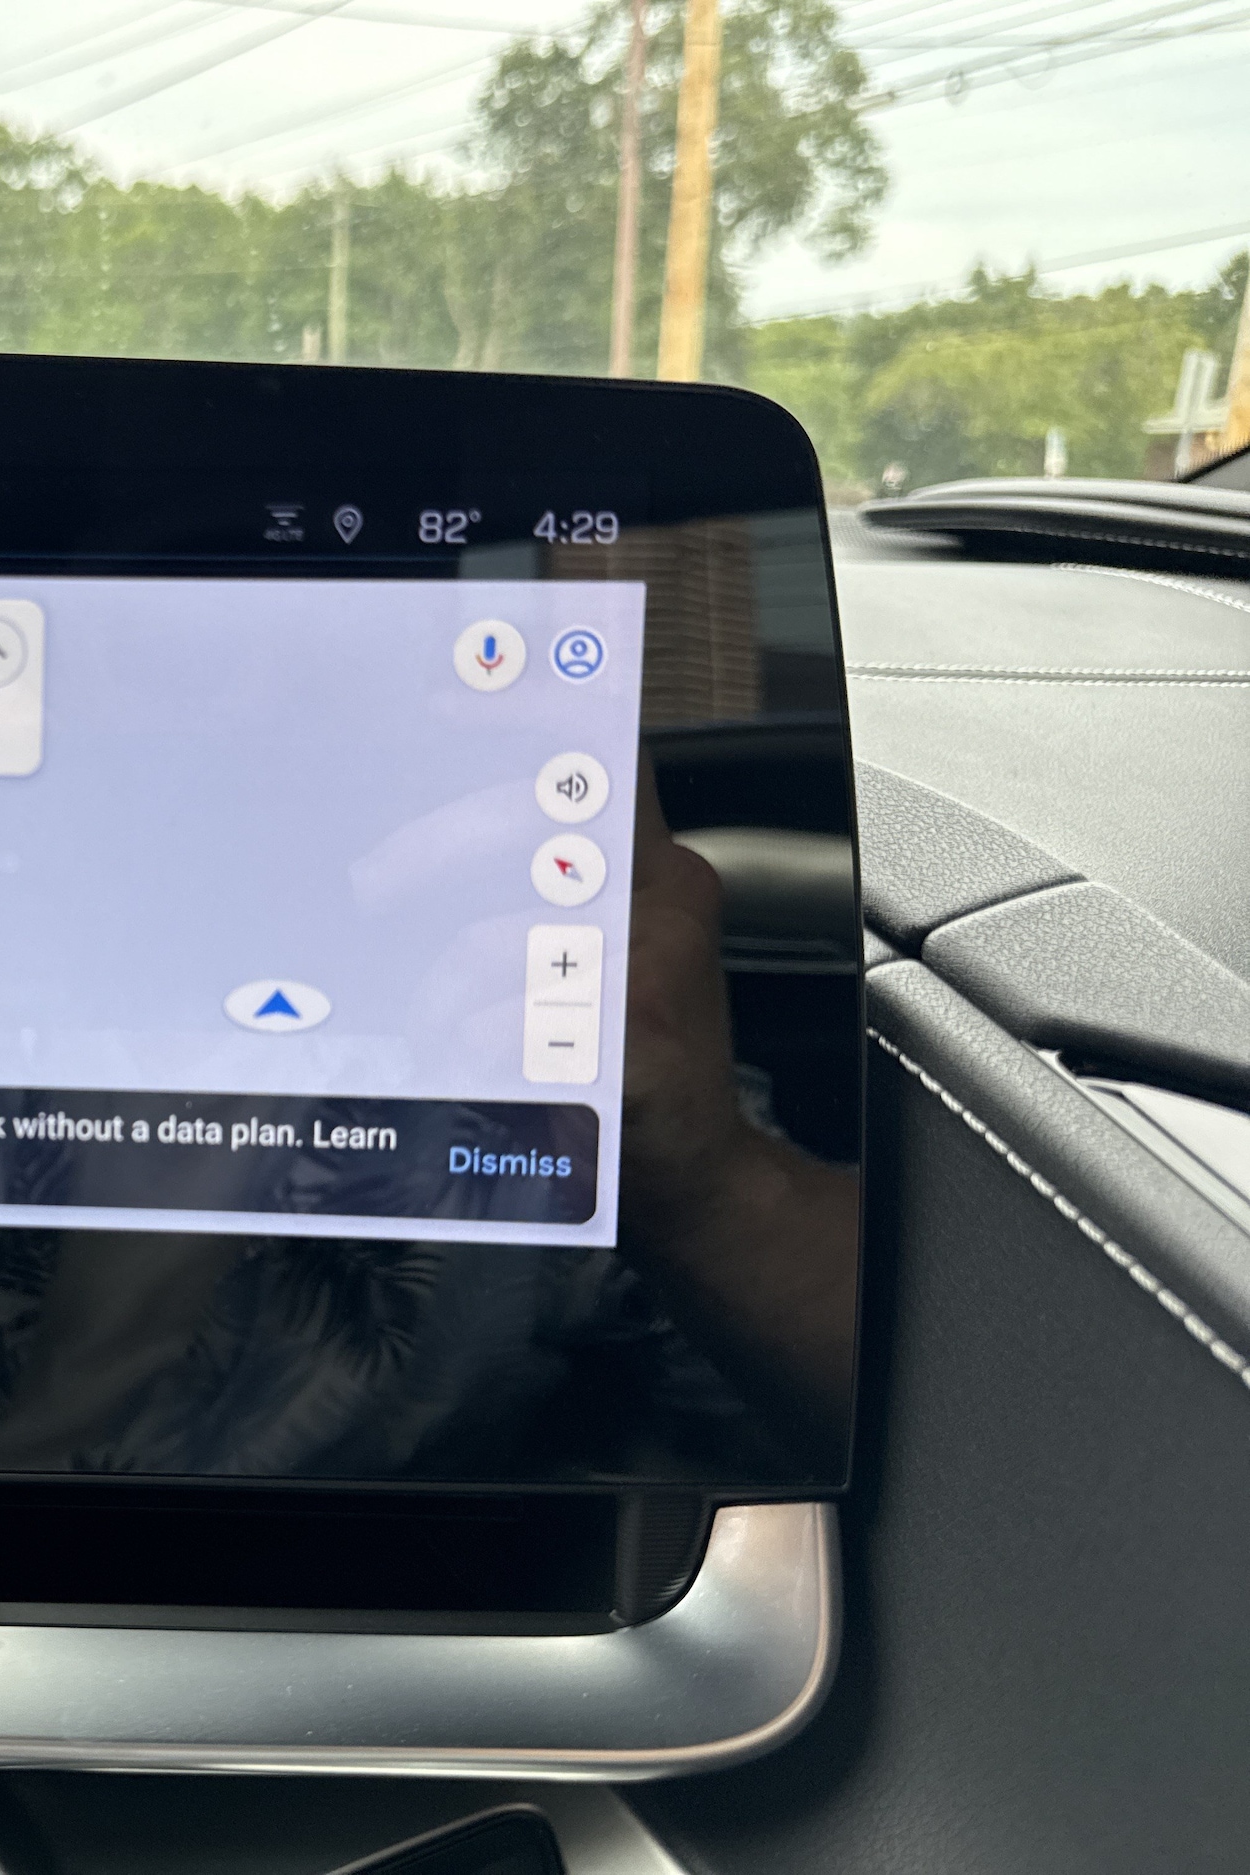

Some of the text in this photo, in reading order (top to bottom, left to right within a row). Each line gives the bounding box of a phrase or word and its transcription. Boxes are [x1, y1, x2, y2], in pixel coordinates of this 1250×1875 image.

[533, 510, 620, 545] 4:29
[12, 1112, 124, 1143] without
[131, 1121, 150, 1142] a
[157, 1115, 224, 1145] data
[230, 1117, 304, 1152] plan.
[313, 1120, 398, 1151] Learn
[448, 1145, 573, 1178] Dismiss
